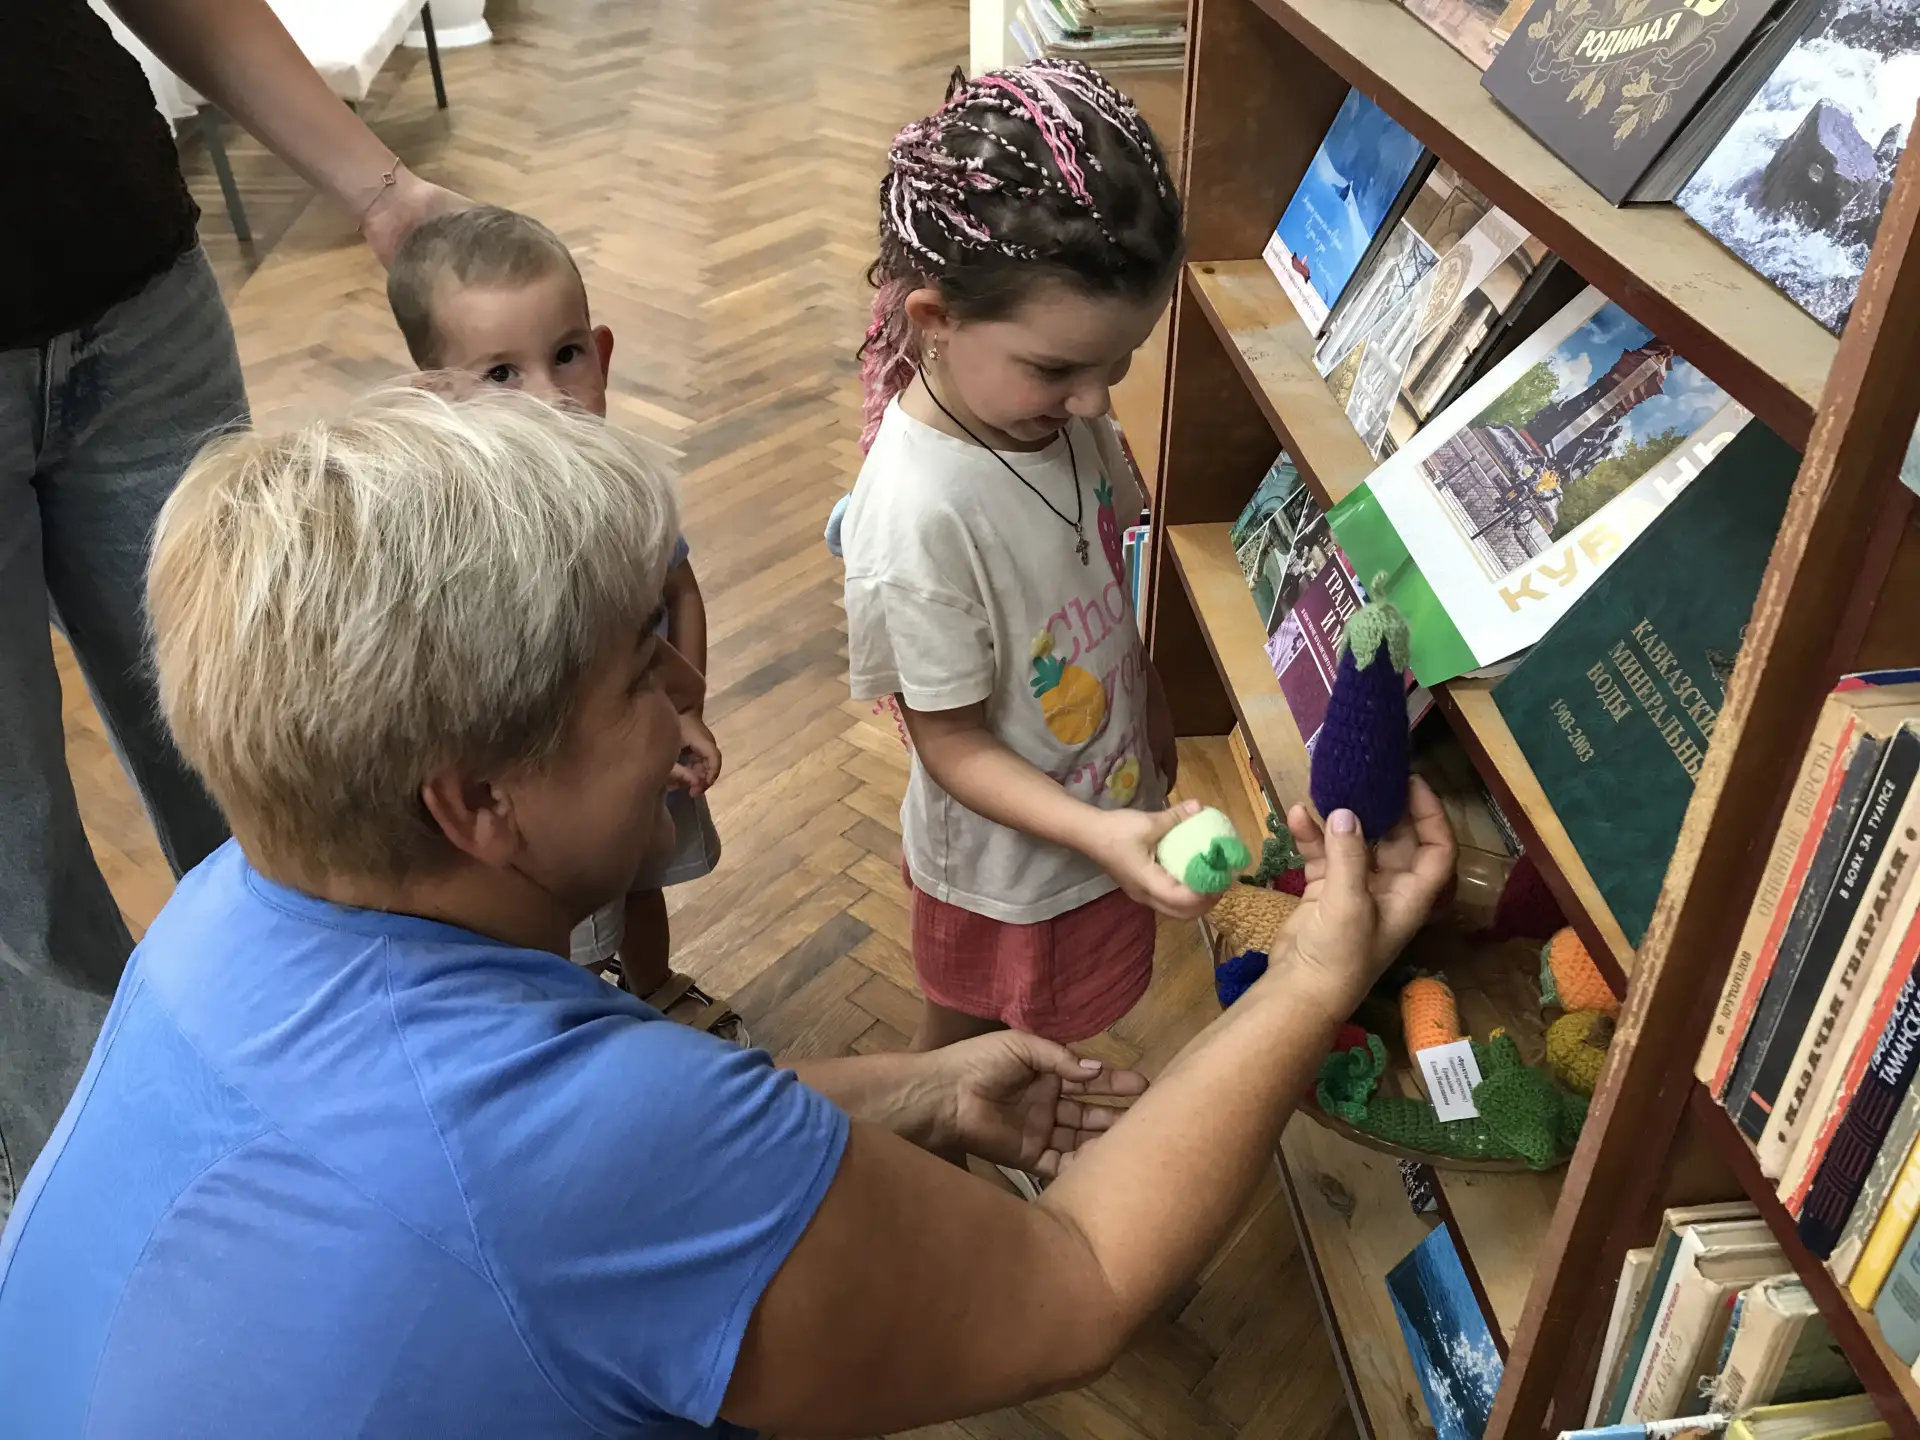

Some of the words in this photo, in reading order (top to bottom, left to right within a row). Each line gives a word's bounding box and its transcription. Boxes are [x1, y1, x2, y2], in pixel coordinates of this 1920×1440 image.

[1575, 12, 1683, 63] РОДИМАЯ
[1586, 660, 1633, 723] ВОДЫ
[1550, 698, 1595, 763] 1903-2003
[1757, 822, 1801, 917] ОГНЕННЫЕ
[1795, 741, 1834, 819] ВЕРСТЫ
[1868, 779, 1896, 829] ТУАПСЕ
[1844, 852, 1865, 888] БОЯХ
[1859, 833, 1874, 852] ЗА
[1839, 888, 1850, 900] В
[1785, 994, 1843, 1127] КАЗАЧЬЯ
[1840, 847, 1909, 991] ГВАРДИЯ
[1878, 990, 1920, 1085] ТАМАНСК
